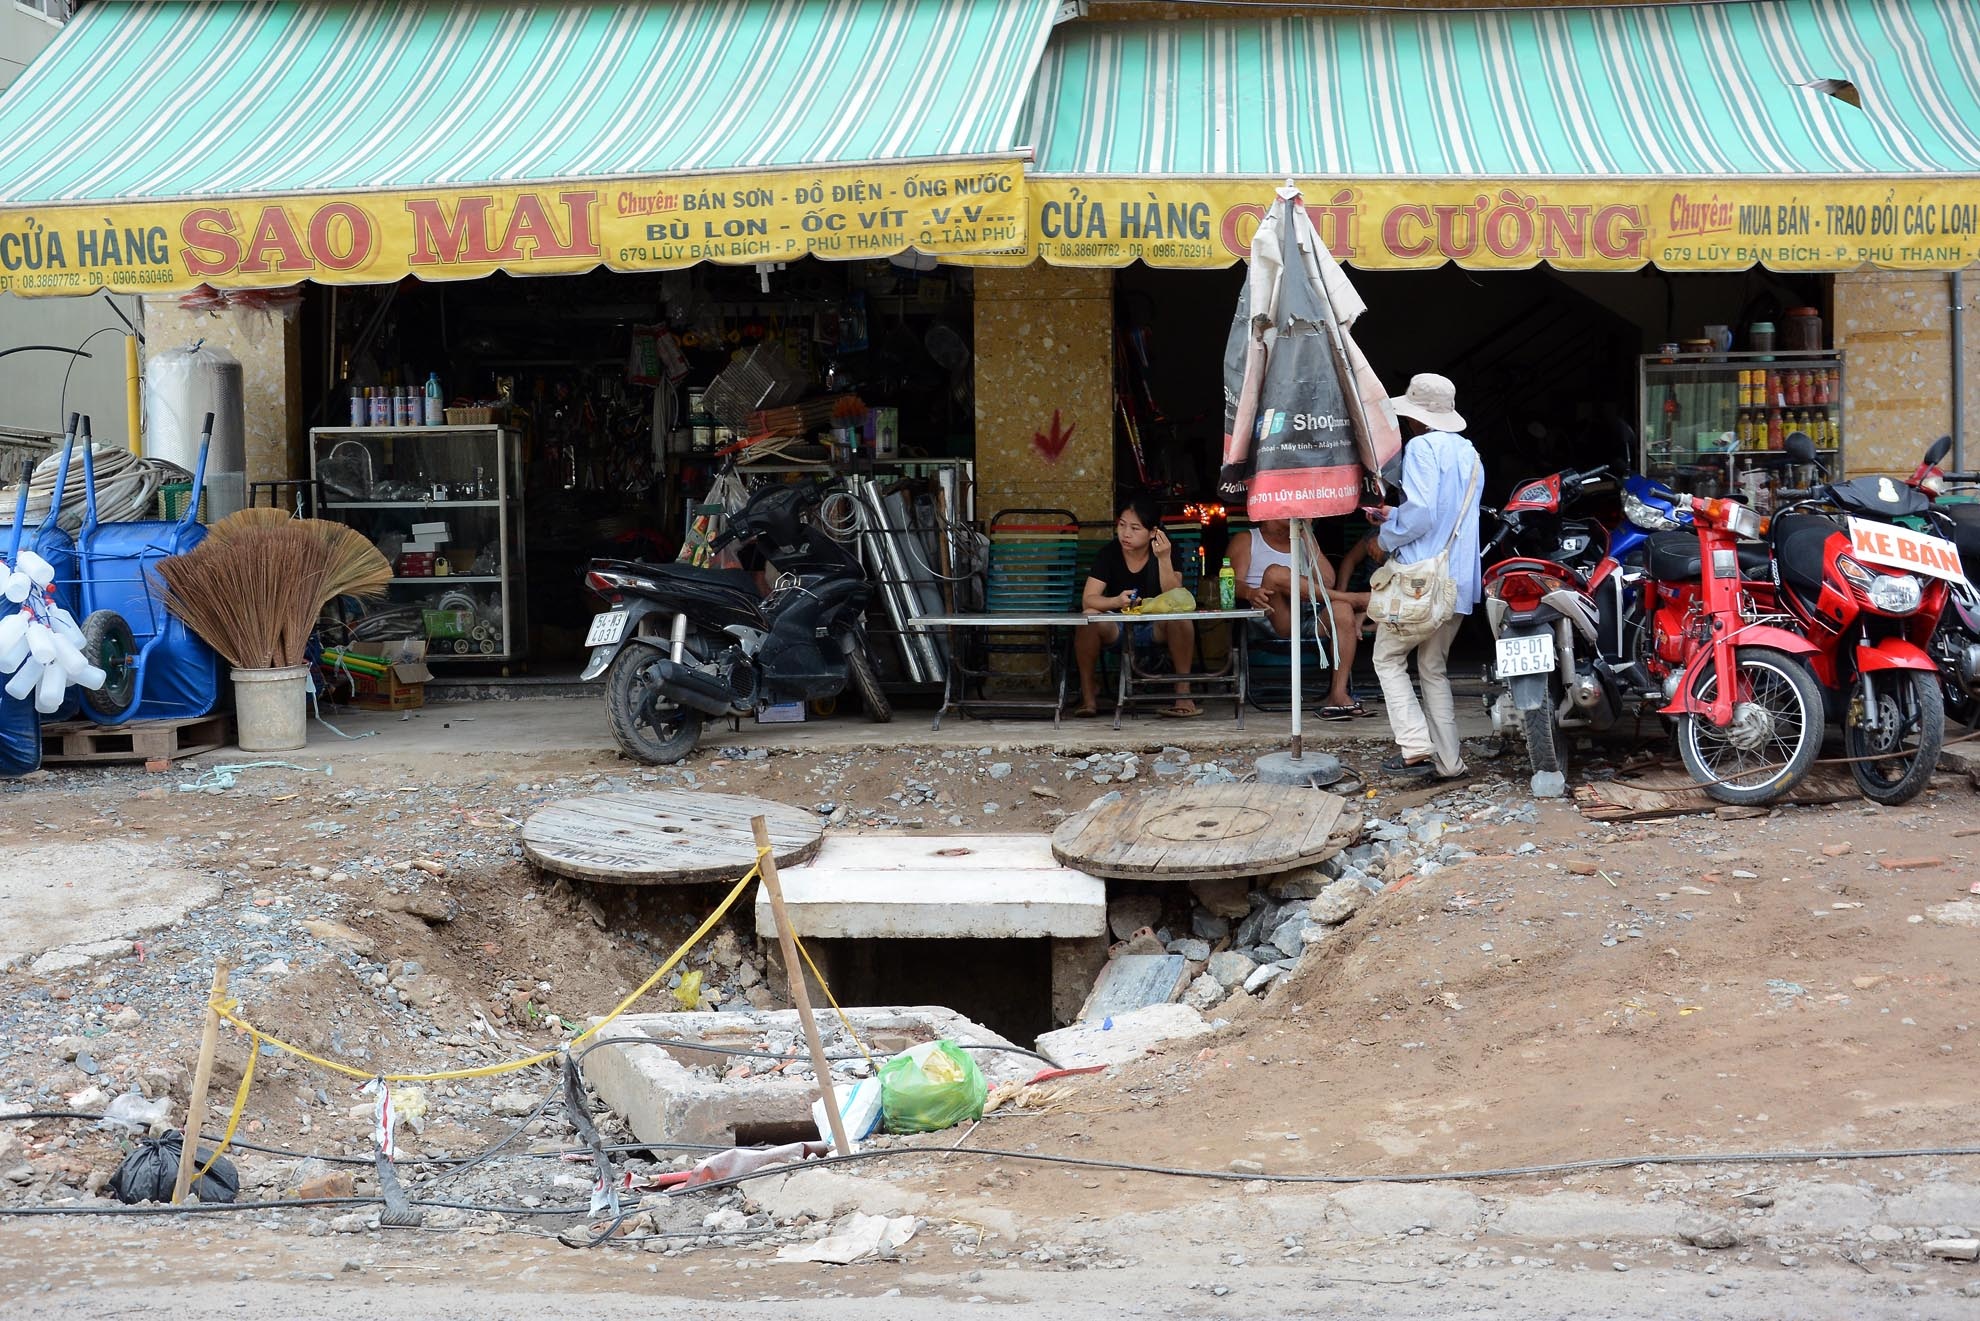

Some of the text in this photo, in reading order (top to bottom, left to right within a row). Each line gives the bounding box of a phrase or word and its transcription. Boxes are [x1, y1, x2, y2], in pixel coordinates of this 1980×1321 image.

[617, 189, 679, 216] Chuyên:
[683, 188, 726, 212] BÁN
[733, 187, 774, 208] SƠN
[795, 178, 824, 204] ĐỒ
[832, 179, 882, 205] ĐIỆN
[903, 173, 947, 198] ỐNG
[955, 171, 1012, 196] NƯỚC
[1041, 187, 1211, 241] CỬA HÀNG
[1669, 192, 1734, 236] Chuyên:
[1738, 204, 1772, 236] MUA
[1777, 196, 1810, 236] BÁN
[1825, 204, 1866, 236] TRAO
[1871, 188, 1898, 236] ĐỔI
[1904, 196, 1936, 236] CÁC
[1941, 203, 1977, 242] LOẠI
[0, 216, 170, 271] CỬA HÀNG
[180, 190, 601, 277] SAO MAI
[619, 247, 647, 262] 679
[652, 242, 685, 260] LŨY
[690, 240, 726, 258] BÁN
[731, 238, 770, 256] BÍCH
[806, 233, 841, 251] PHÚ
[847, 233, 905, 251] THẠNH
[942, 226, 977, 244] TÂN
[982, 222, 1016, 241] PHÚ
[646, 218, 690, 242] BÙ
[704, 218, 768, 239] LON
[801, 207, 847, 232] ỐC
[857, 206, 909, 229] VÍT
[1220, 188, 1648, 259] CÍ CƯỜNG
[1060, 243, 1120, 258] 08.38607762
[1153, 243, 1213, 258] 0986.762914
[1663, 247, 1692, 261] 679
[1697, 244, 1731, 261] LŨY
[1736, 244, 1772, 262] BÁN
[1778, 244, 1820, 261] BÍCH
[1857, 244, 1894, 262] PHÚ
[1900, 247, 1961, 264] THẠNH
[22, 272, 80, 289] 08.38607762
[112, 269, 174, 285] 0906.630466
[1853, 529, 1962, 575] XE BÁN
[1502, 654, 1550, 673] 216.54
